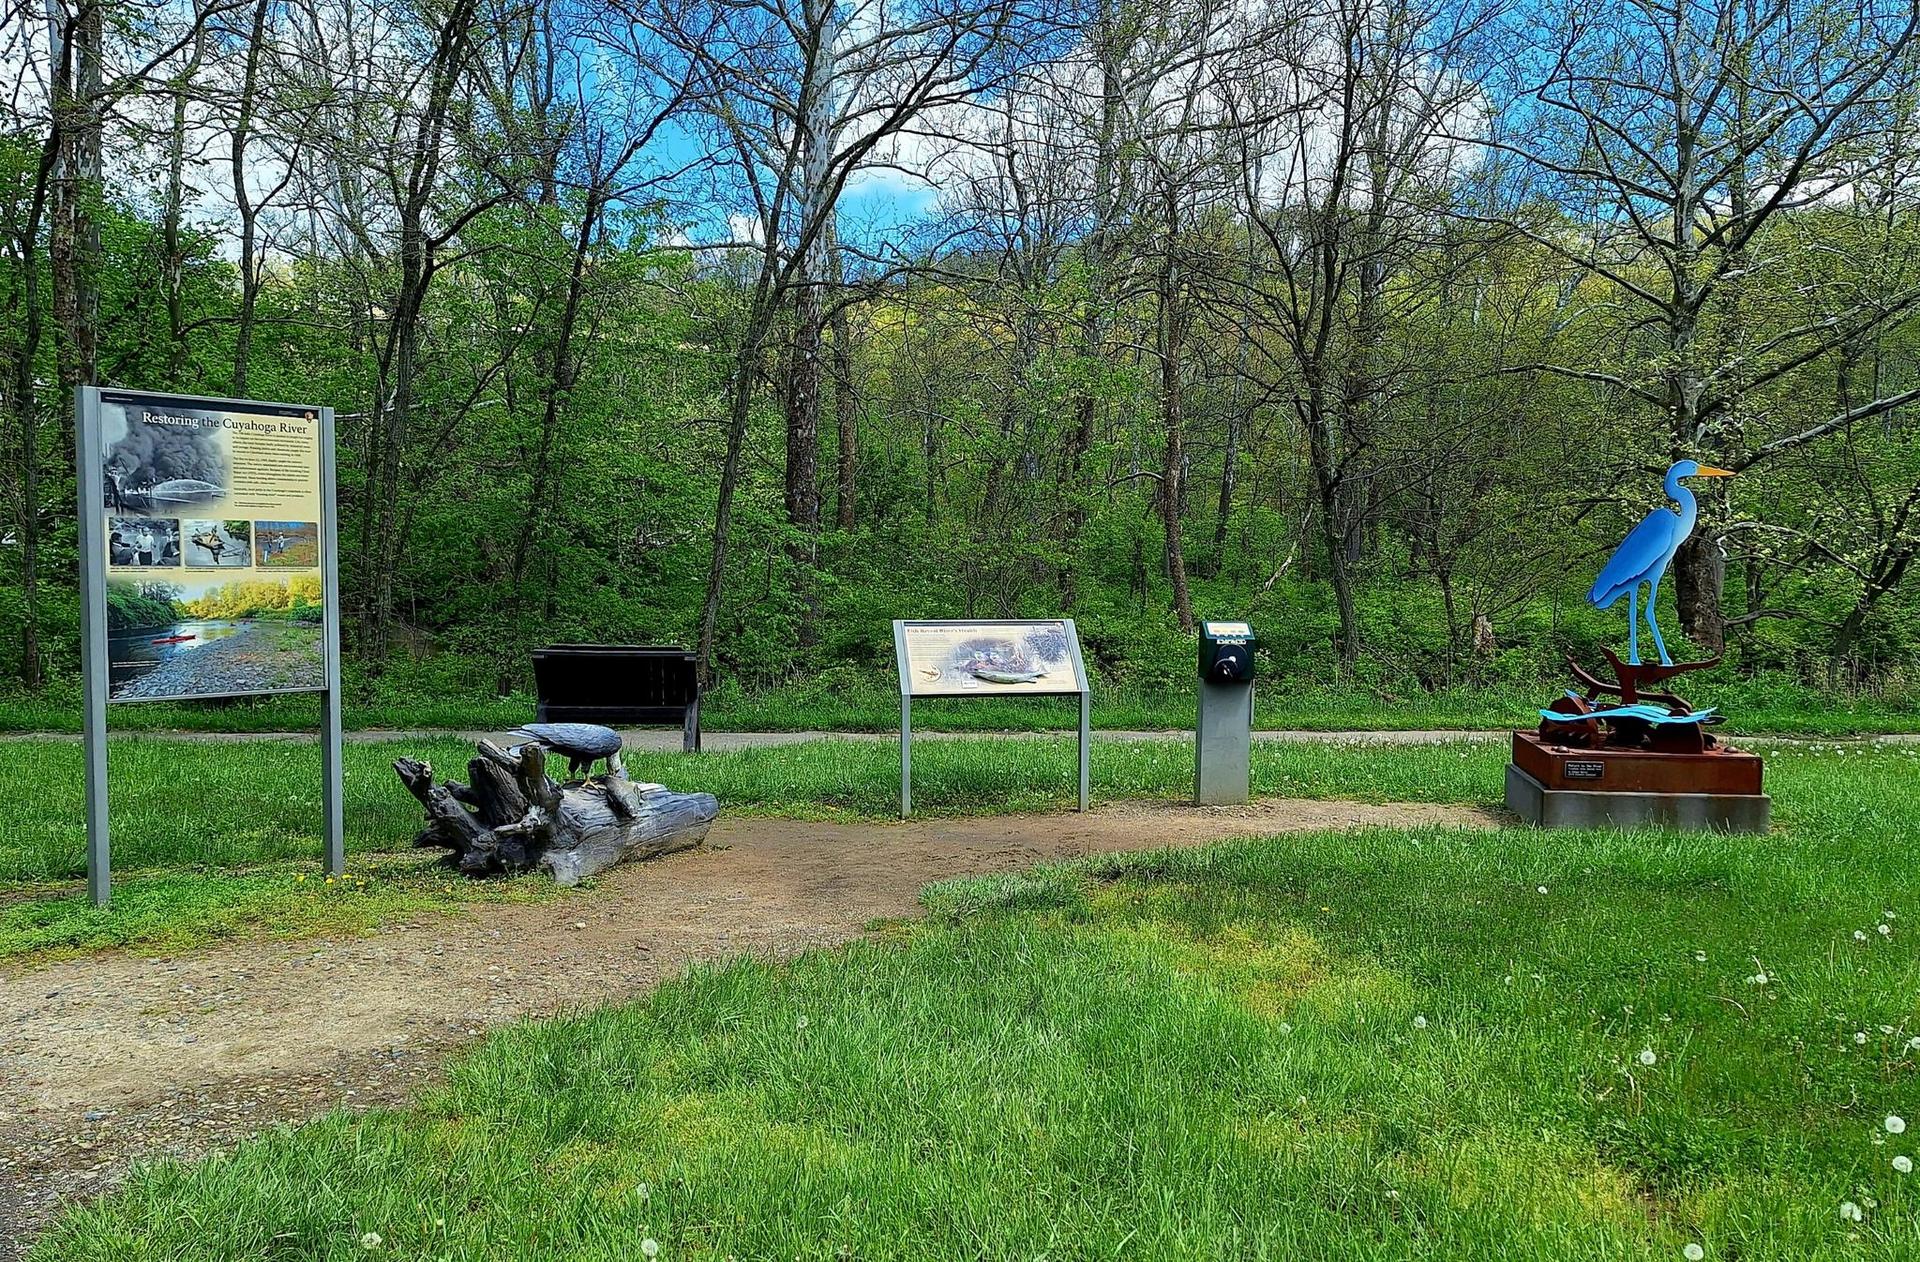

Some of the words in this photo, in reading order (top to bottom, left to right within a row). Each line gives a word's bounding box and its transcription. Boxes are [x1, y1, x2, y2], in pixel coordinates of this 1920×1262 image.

[142, 411, 199, 430] Restoring
[202, 416, 220, 428] the
[222, 417, 277, 434] Cuyahoga
[279, 422, 307, 434] River
